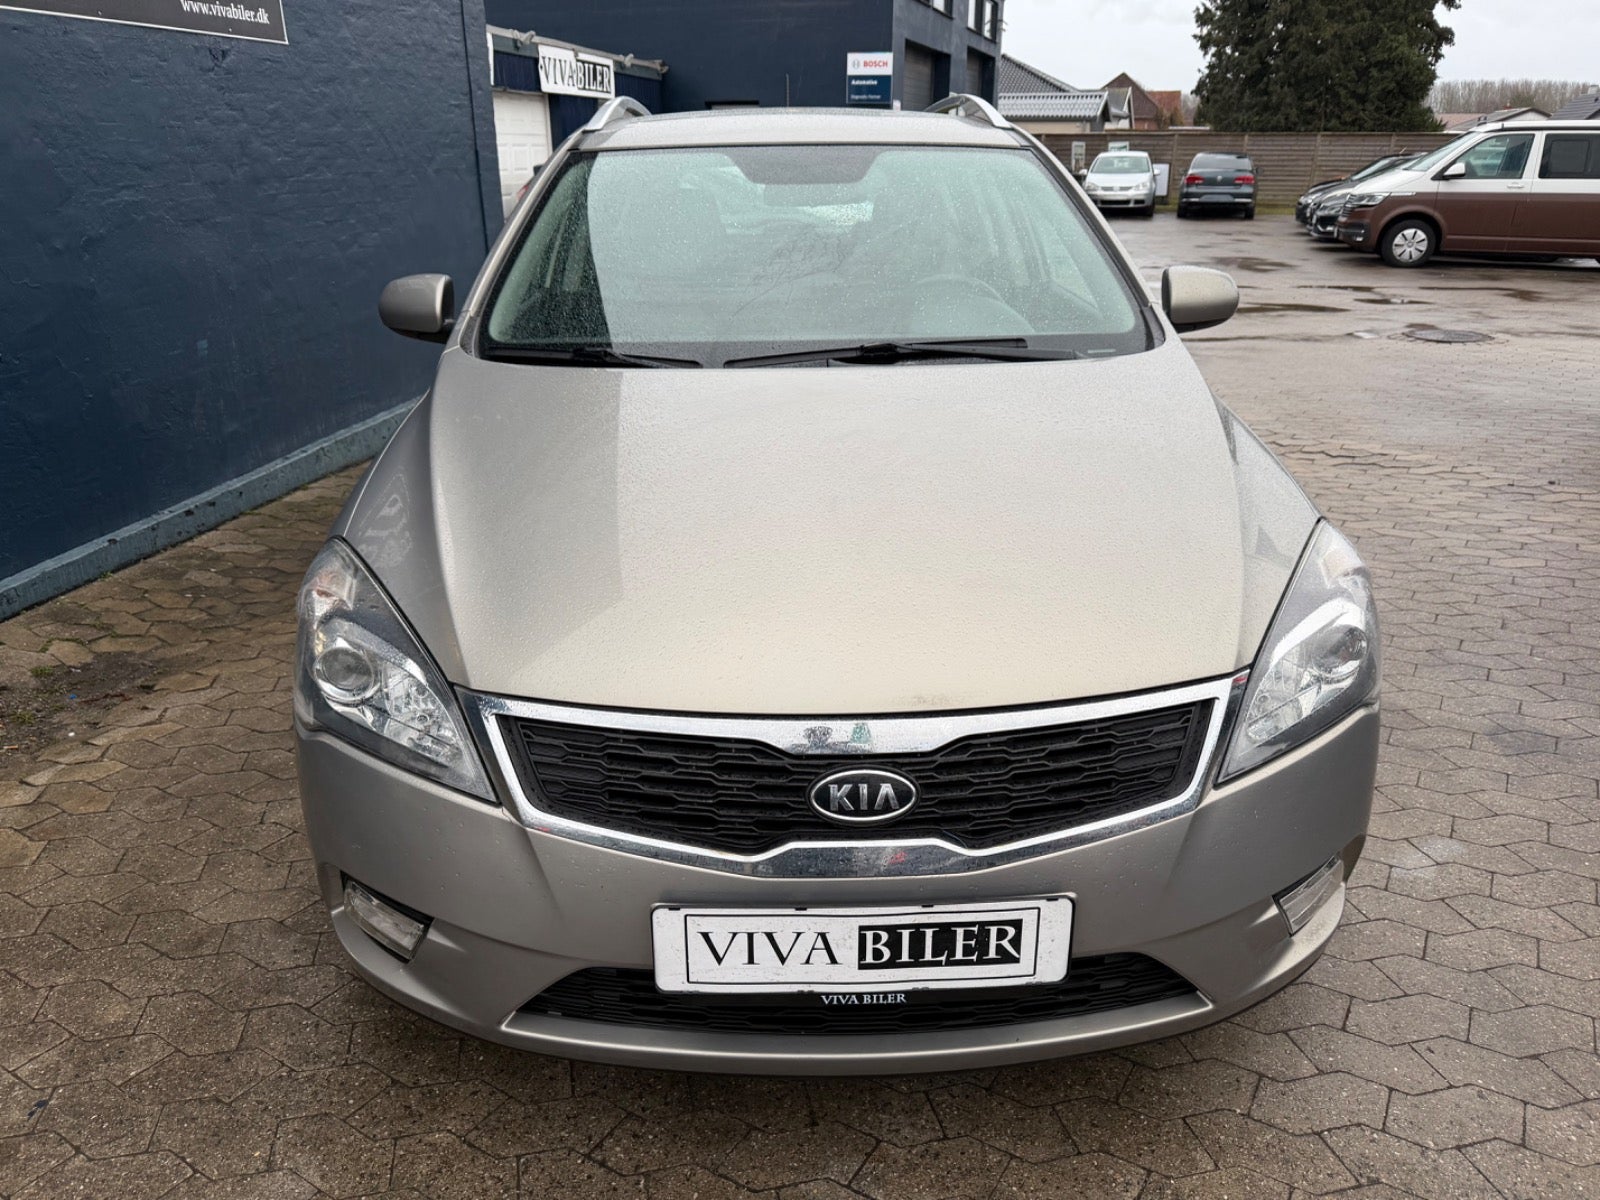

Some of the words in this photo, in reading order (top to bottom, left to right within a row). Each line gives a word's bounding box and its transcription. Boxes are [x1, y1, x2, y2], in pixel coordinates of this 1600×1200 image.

[181, 0, 270, 24] www.vivabiler.dk
[541, 56, 576, 87] VIVA
[576, 61, 611, 92] BILER
[828, 783, 900, 811] KIA
[697, 930, 843, 966] VIVA
[859, 925, 1020, 966] BILER
[820, 994, 860, 1005] VIVA
[862, 993, 907, 1005] BILER
